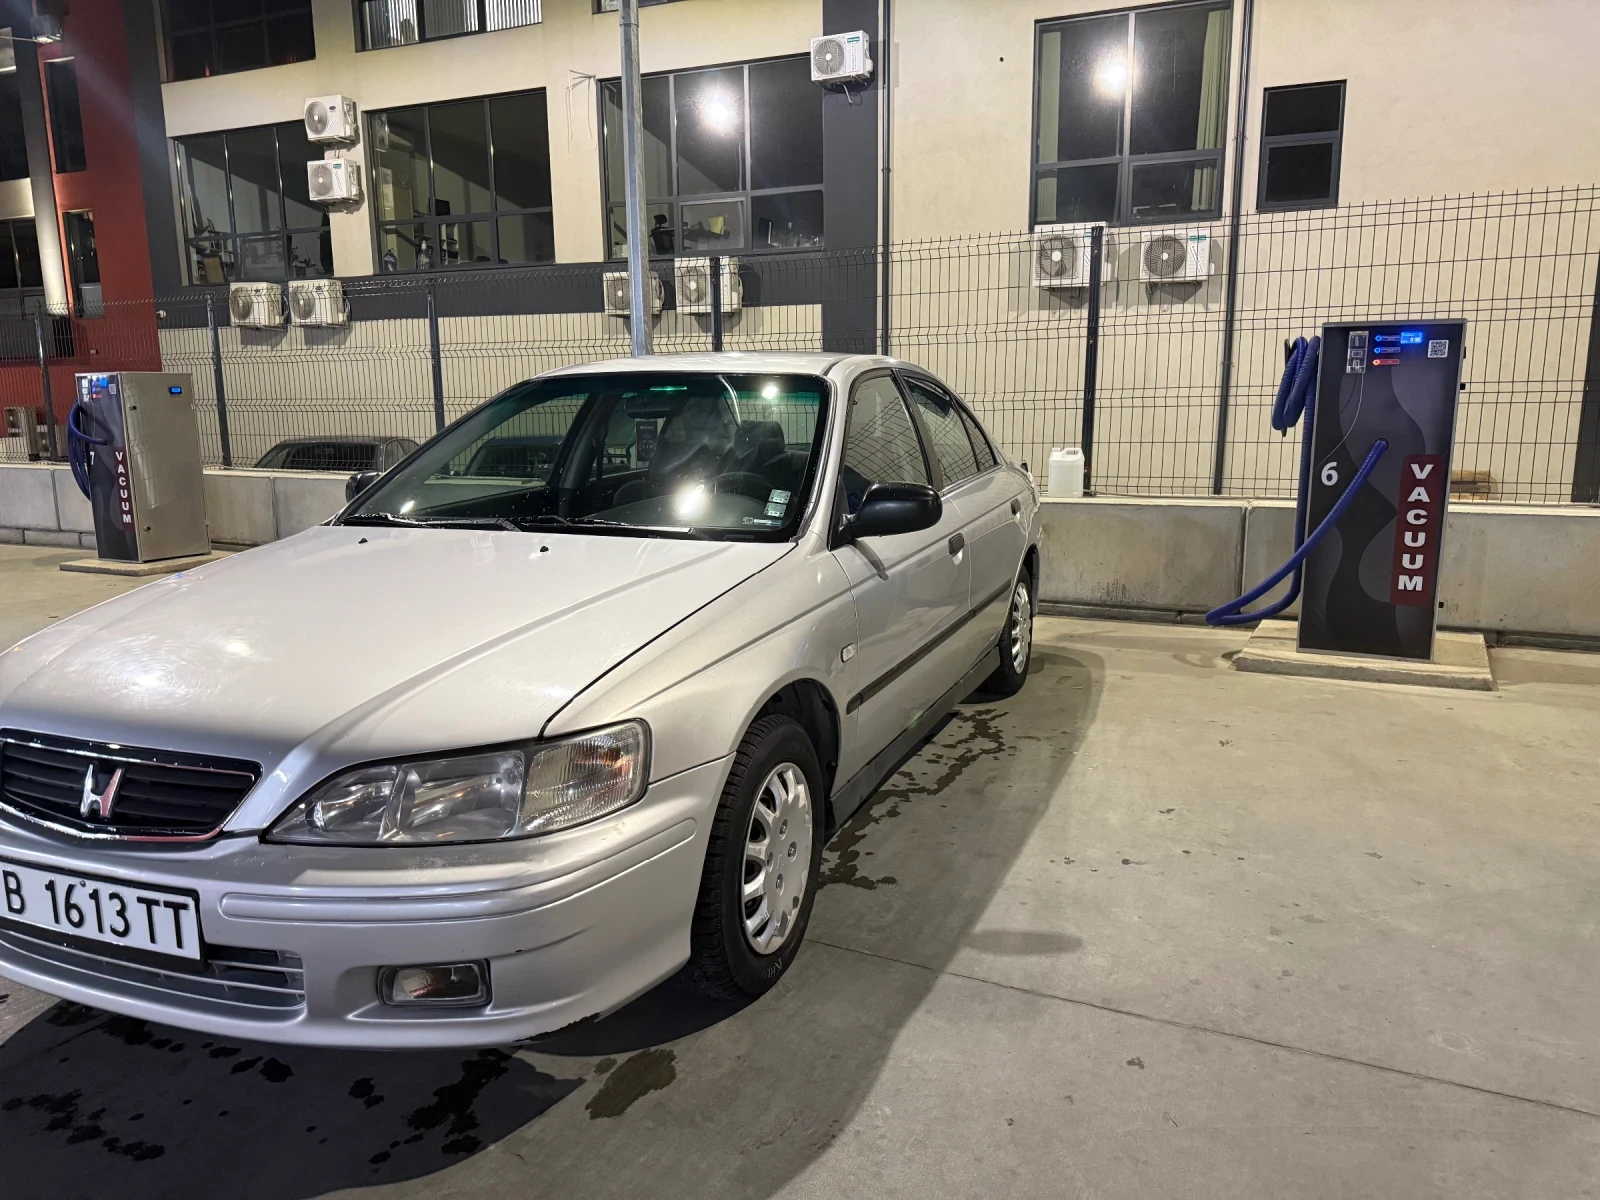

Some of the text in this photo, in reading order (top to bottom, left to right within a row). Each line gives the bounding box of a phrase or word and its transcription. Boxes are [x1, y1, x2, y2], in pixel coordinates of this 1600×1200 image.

[89, 451, 95, 465] 7
[115, 451, 132, 524] VACUUM
[1321, 461, 1339, 486] 6
[1397, 463, 1434, 592] VACUUM
[2, 869, 190, 949] B 1613 TT
